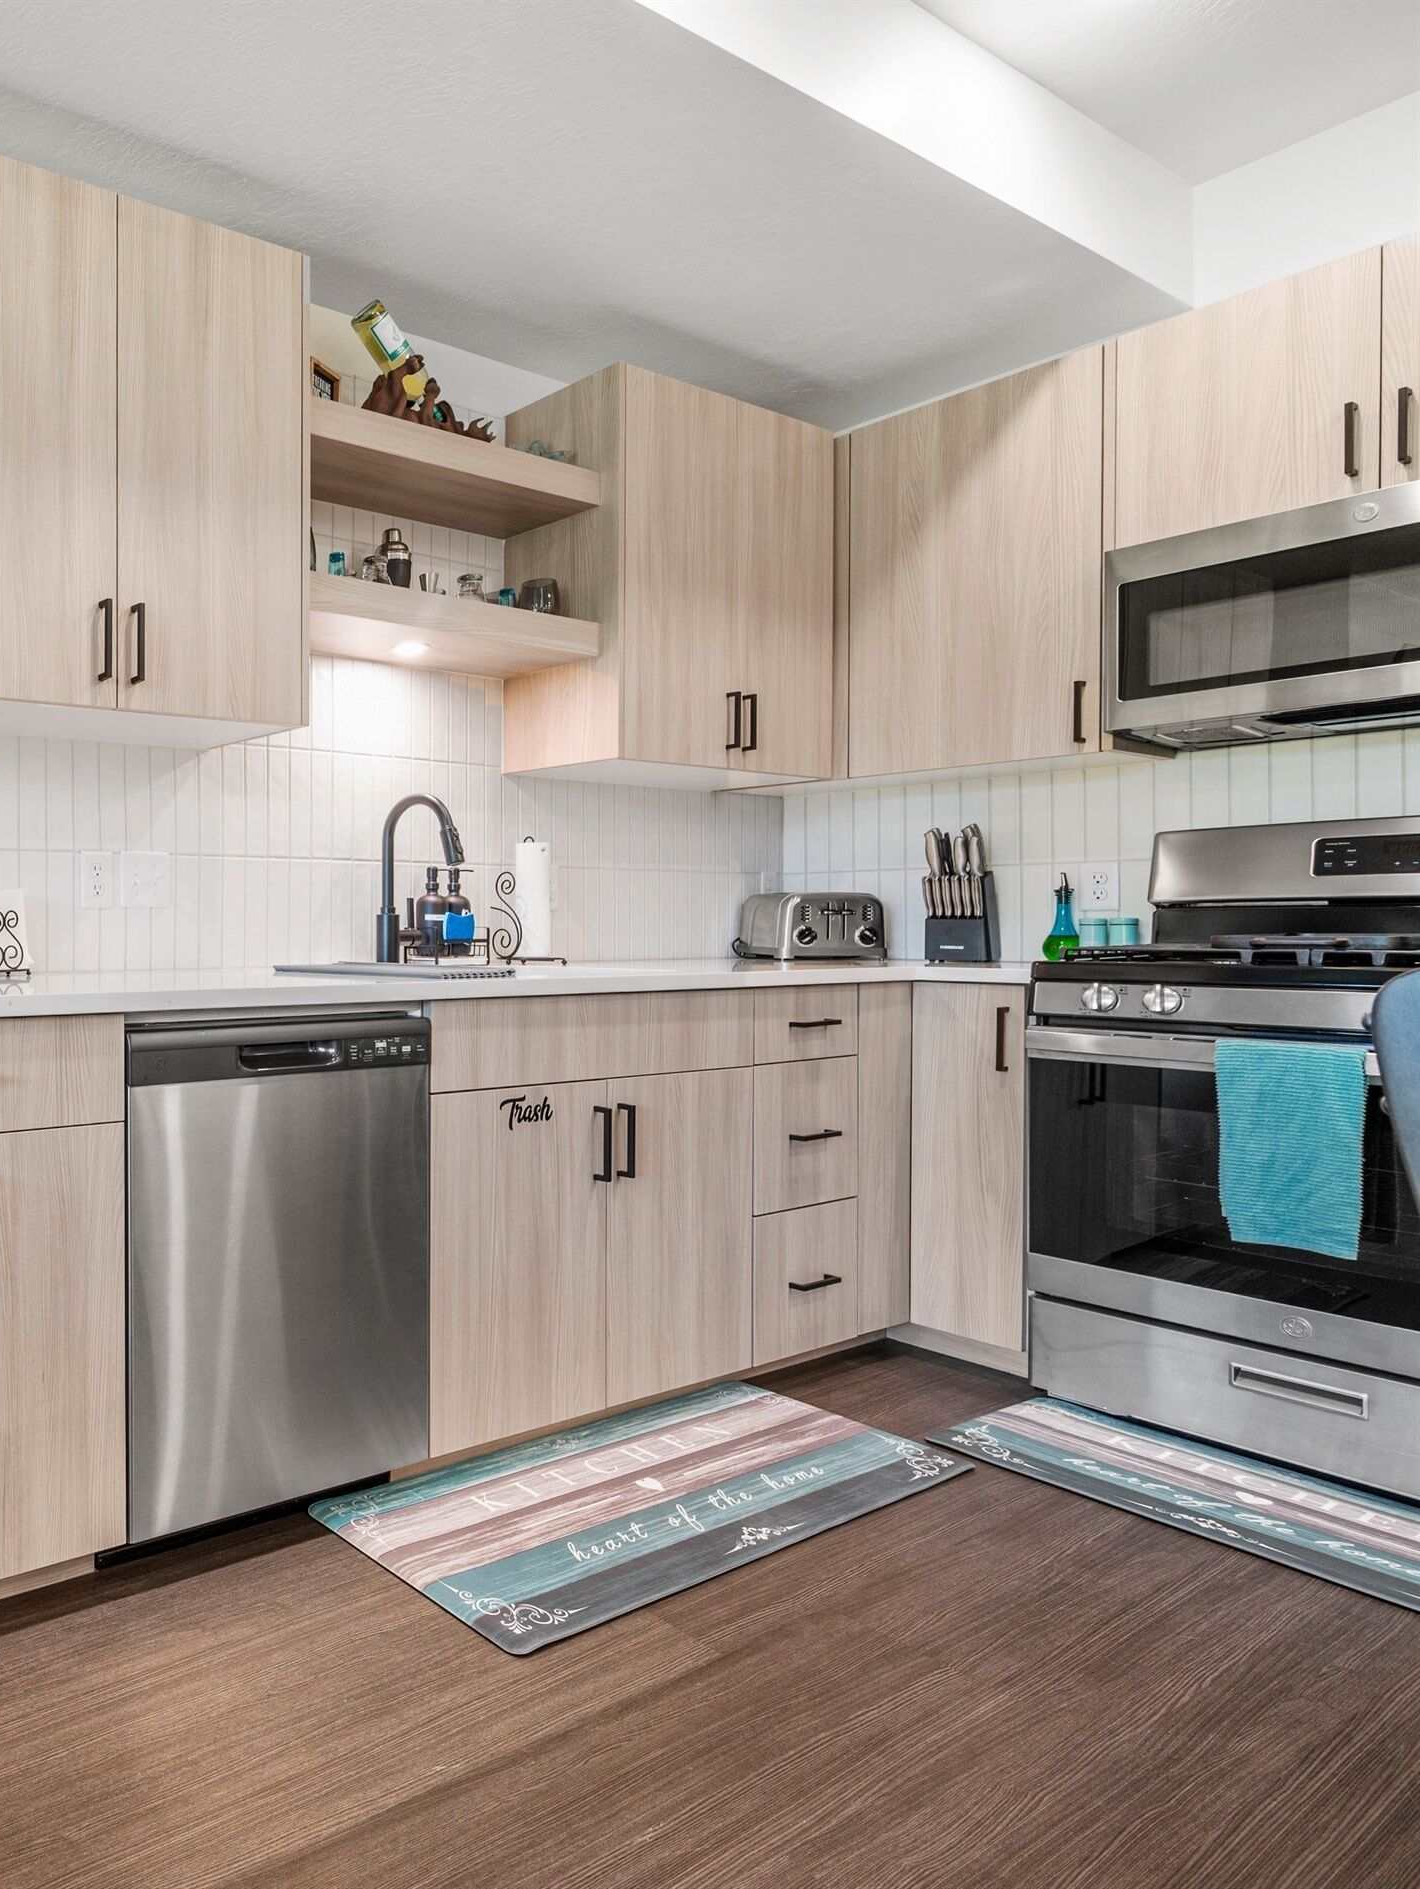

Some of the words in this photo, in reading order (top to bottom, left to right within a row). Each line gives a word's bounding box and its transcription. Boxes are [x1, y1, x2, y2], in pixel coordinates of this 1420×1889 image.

[499, 1094, 554, 1131] Trash
[469, 1423, 732, 1512] KITCHEN
[568, 1522, 648, 1562] heart
[669, 1504, 705, 1532] of
[708, 1488, 753, 1510] the
[760, 1465, 824, 1490] home
[1106, 1436, 1420, 1539] KITCHE
[1063, 1458, 1175, 1493] heart
[1173, 1494, 1232, 1509] of
[1234, 1513, 1297, 1535] the
[1314, 1541, 1420, 1577] home
